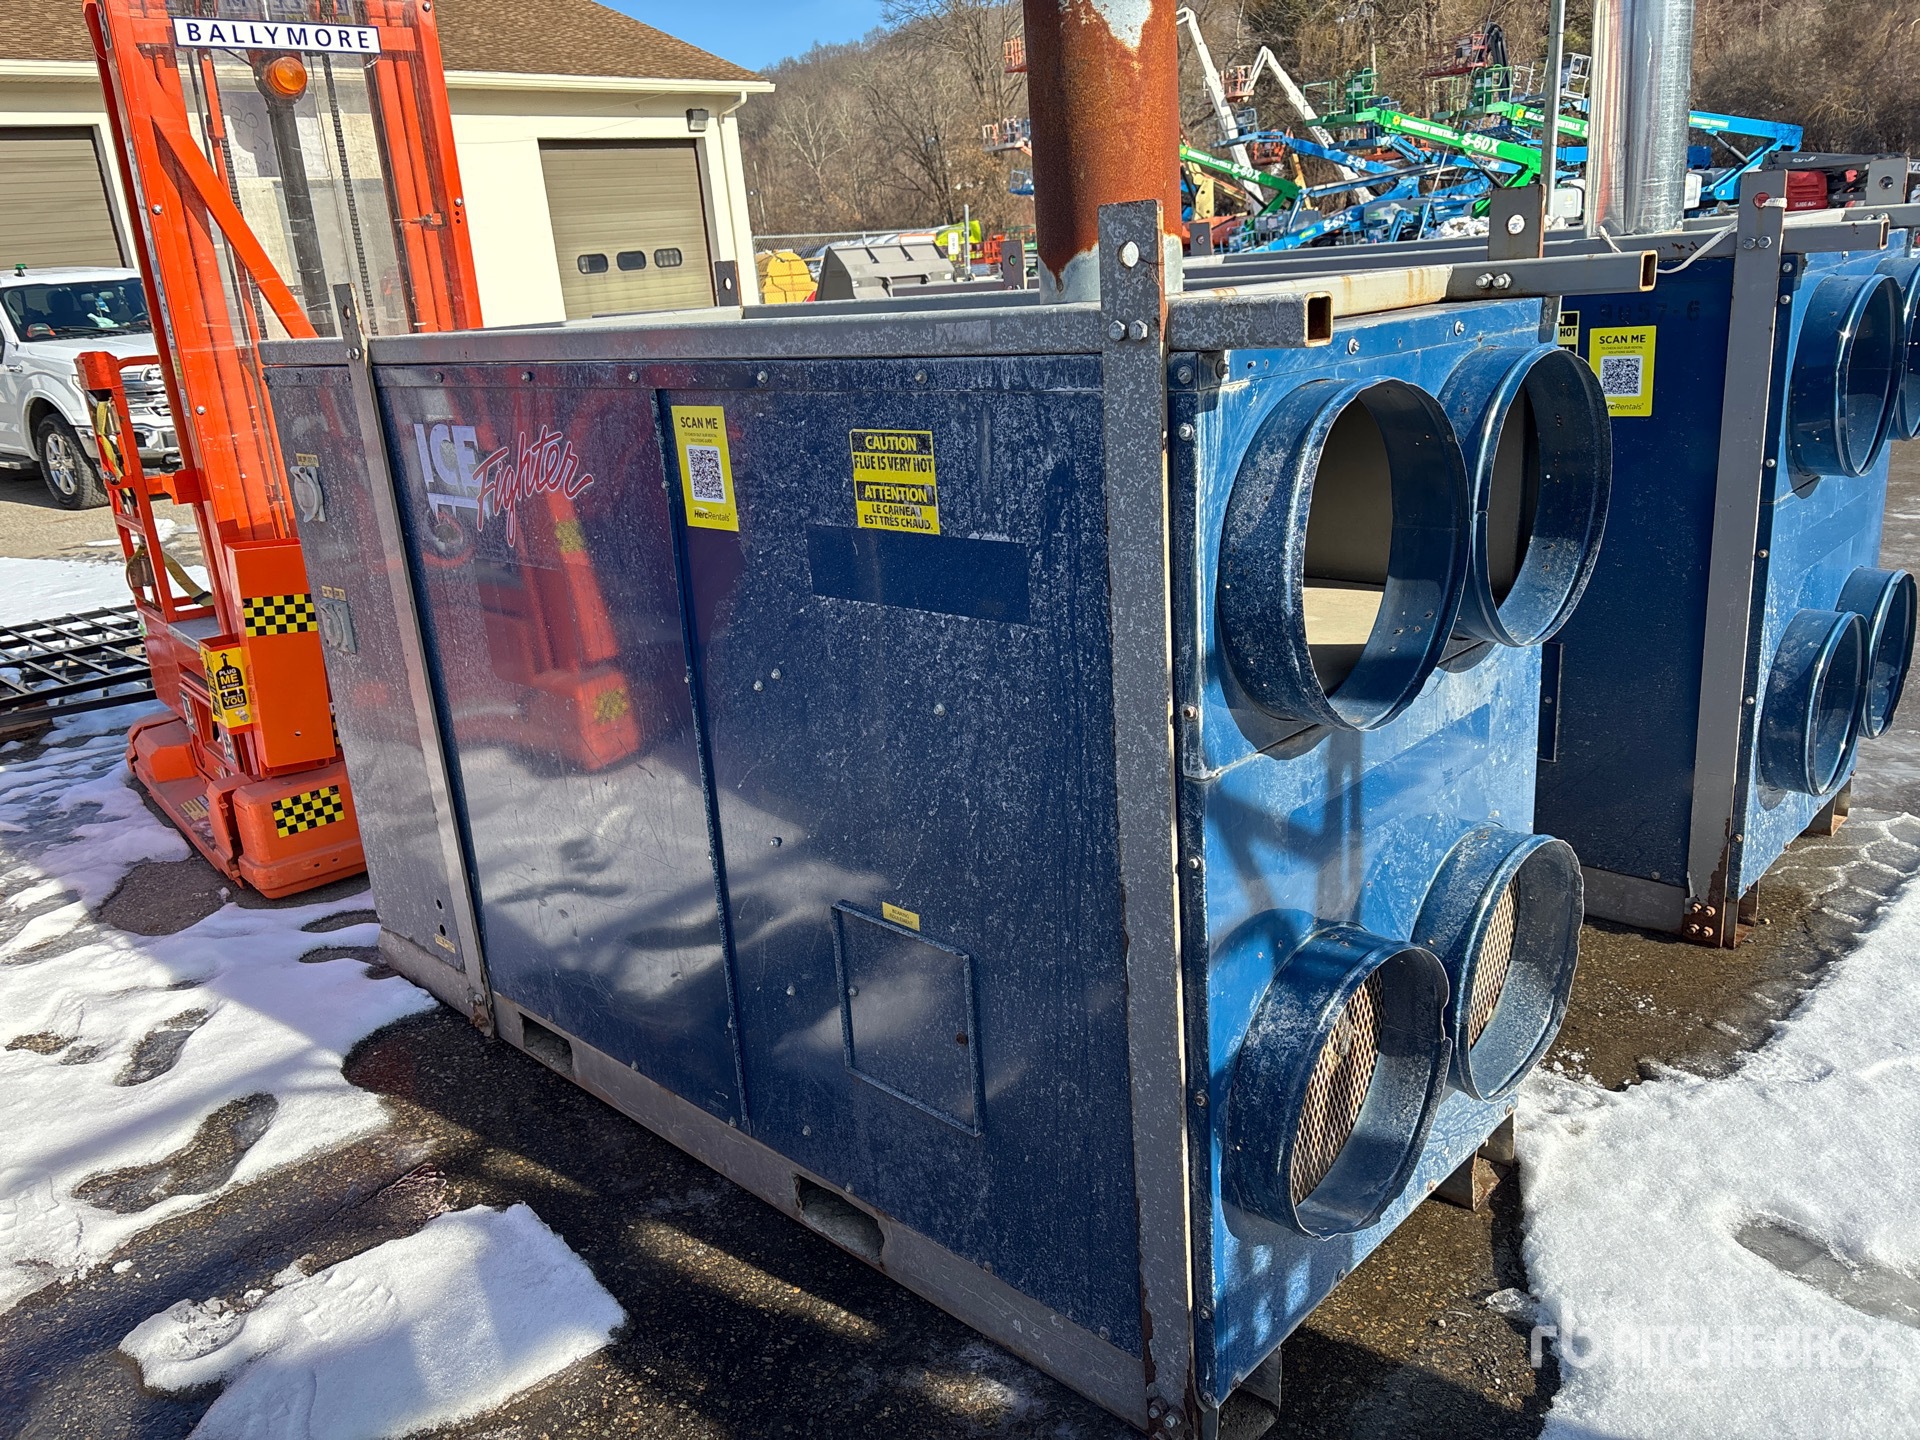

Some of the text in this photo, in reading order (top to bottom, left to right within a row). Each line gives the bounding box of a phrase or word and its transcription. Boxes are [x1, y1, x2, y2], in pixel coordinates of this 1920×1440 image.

[187, 22, 370, 49] BALLYMORE
[1461, 133, 1501, 154] S-60X
[1345, 155, 1367, 169] S-65
[1231, 163, 1262, 181] S-60X
[1323, 210, 1353, 232] S-60X
[1559, 327, 1577, 337] HOT
[1599, 334, 1647, 345] SCAN ME
[680, 416, 718, 430] SCAN ME
[865, 435, 917, 452] CAUTION
[414, 423, 481, 496] ICE
[854, 454, 933, 474] FLUE IS VERY HOT
[472, 424, 594, 547] Fighter
[864, 484, 928, 503] ATTENTION
[871, 503, 882, 514] LE
[694, 510, 730, 522] HercRentals
[864, 514, 879, 525] EST
[219, 668, 237, 676] PLUG
[220, 673, 239, 685] ME
[224, 696, 244, 706] YOU
